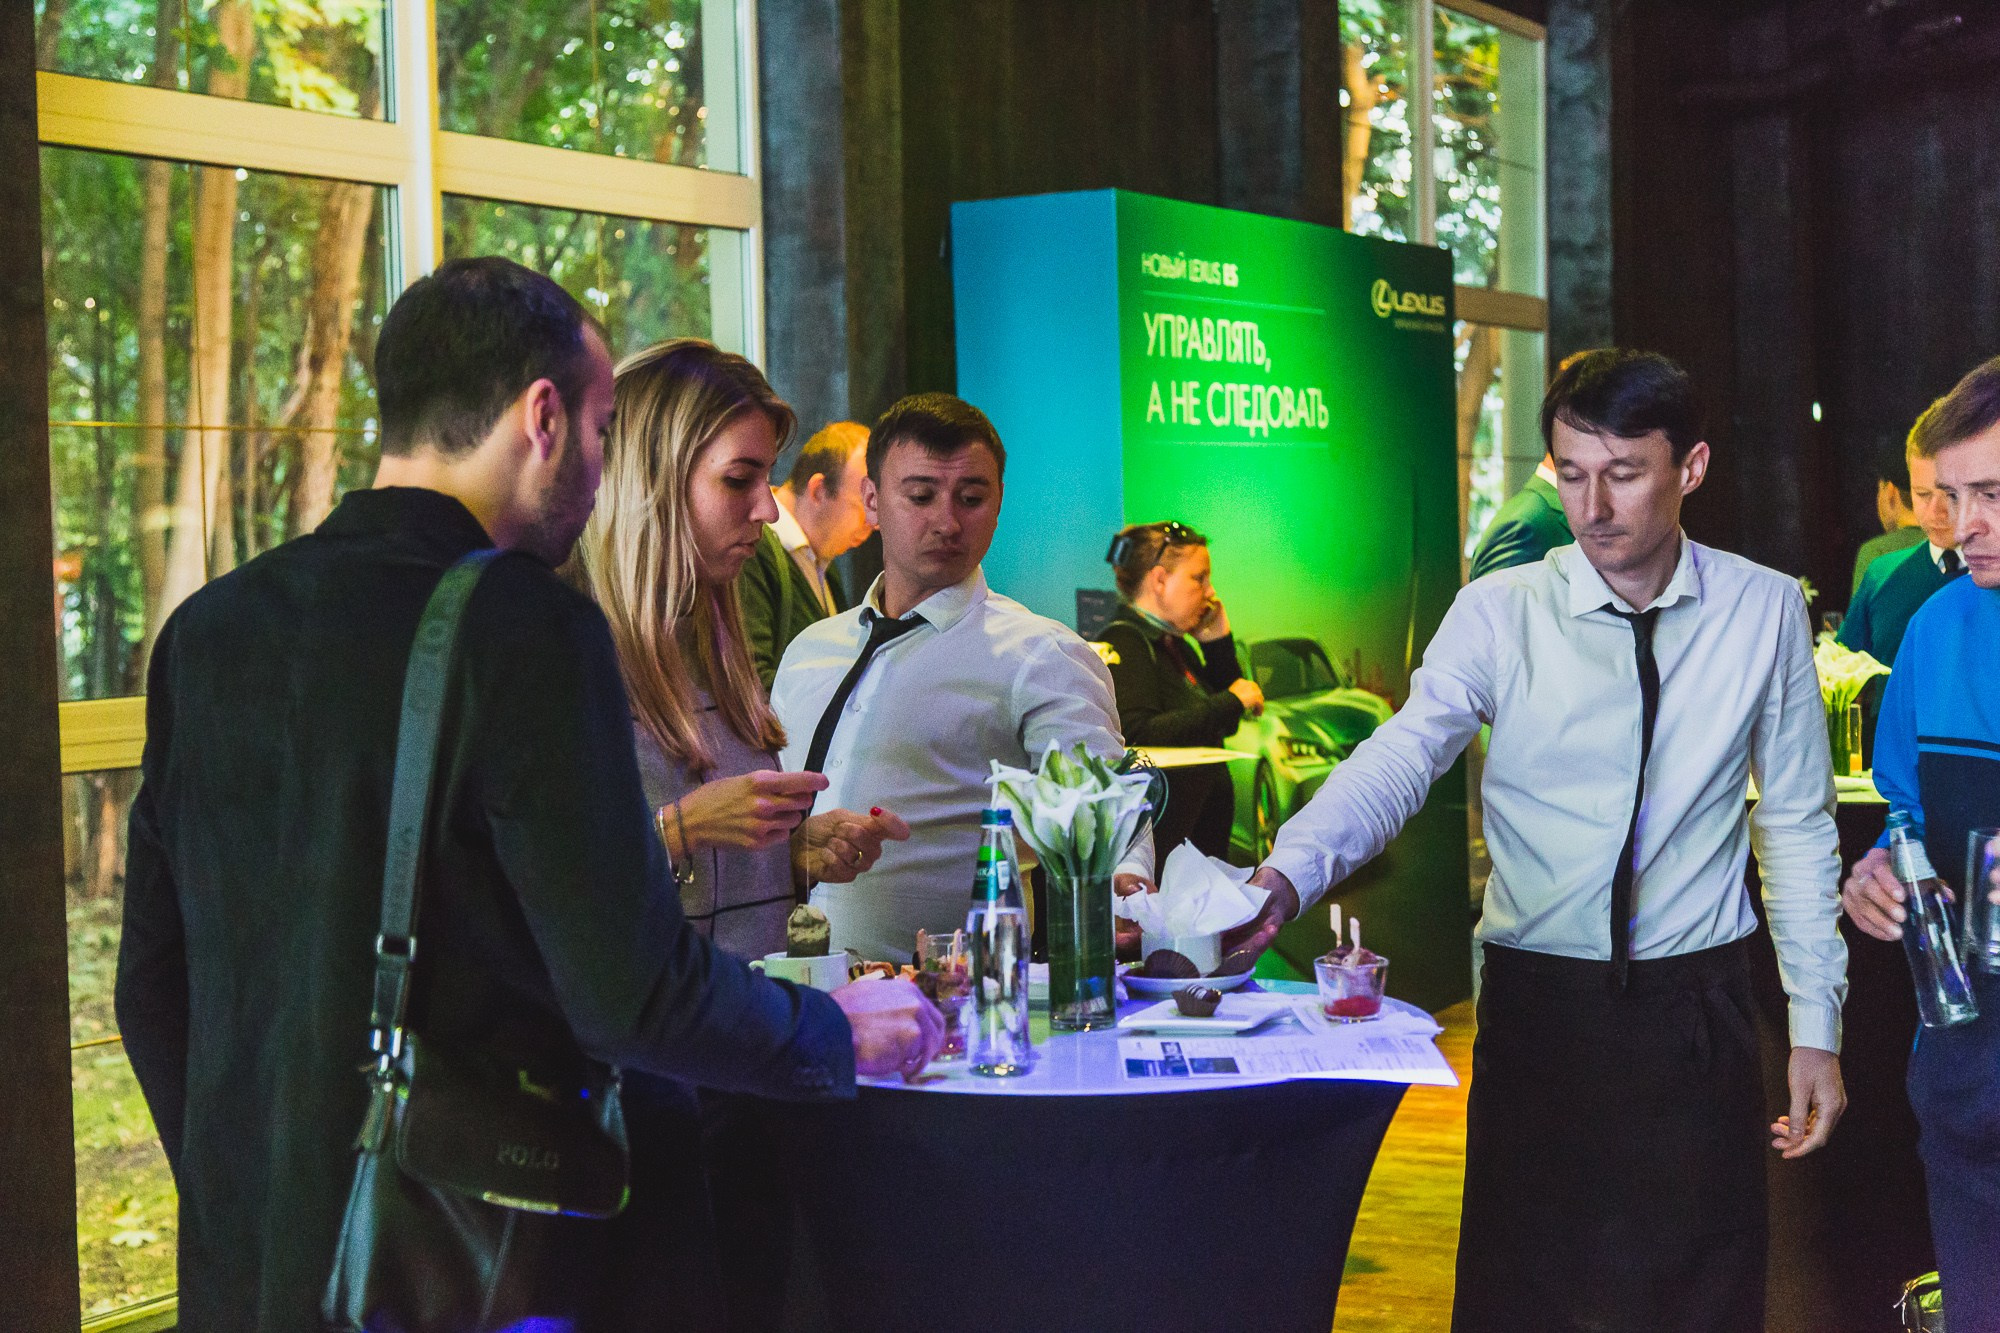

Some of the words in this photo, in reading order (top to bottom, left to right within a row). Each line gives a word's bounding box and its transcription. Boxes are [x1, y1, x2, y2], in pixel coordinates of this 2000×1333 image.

[1390, 289, 1446, 316] LEXUS
[1143, 311, 1272, 374] УПРАВЛЯТЬ,
[1146, 380, 1166, 424] А
[1170, 379, 1202, 426] НЕ
[1206, 381, 1330, 438] СЛЕДОВАТЬ
[496, 1143, 560, 1171] POLO
